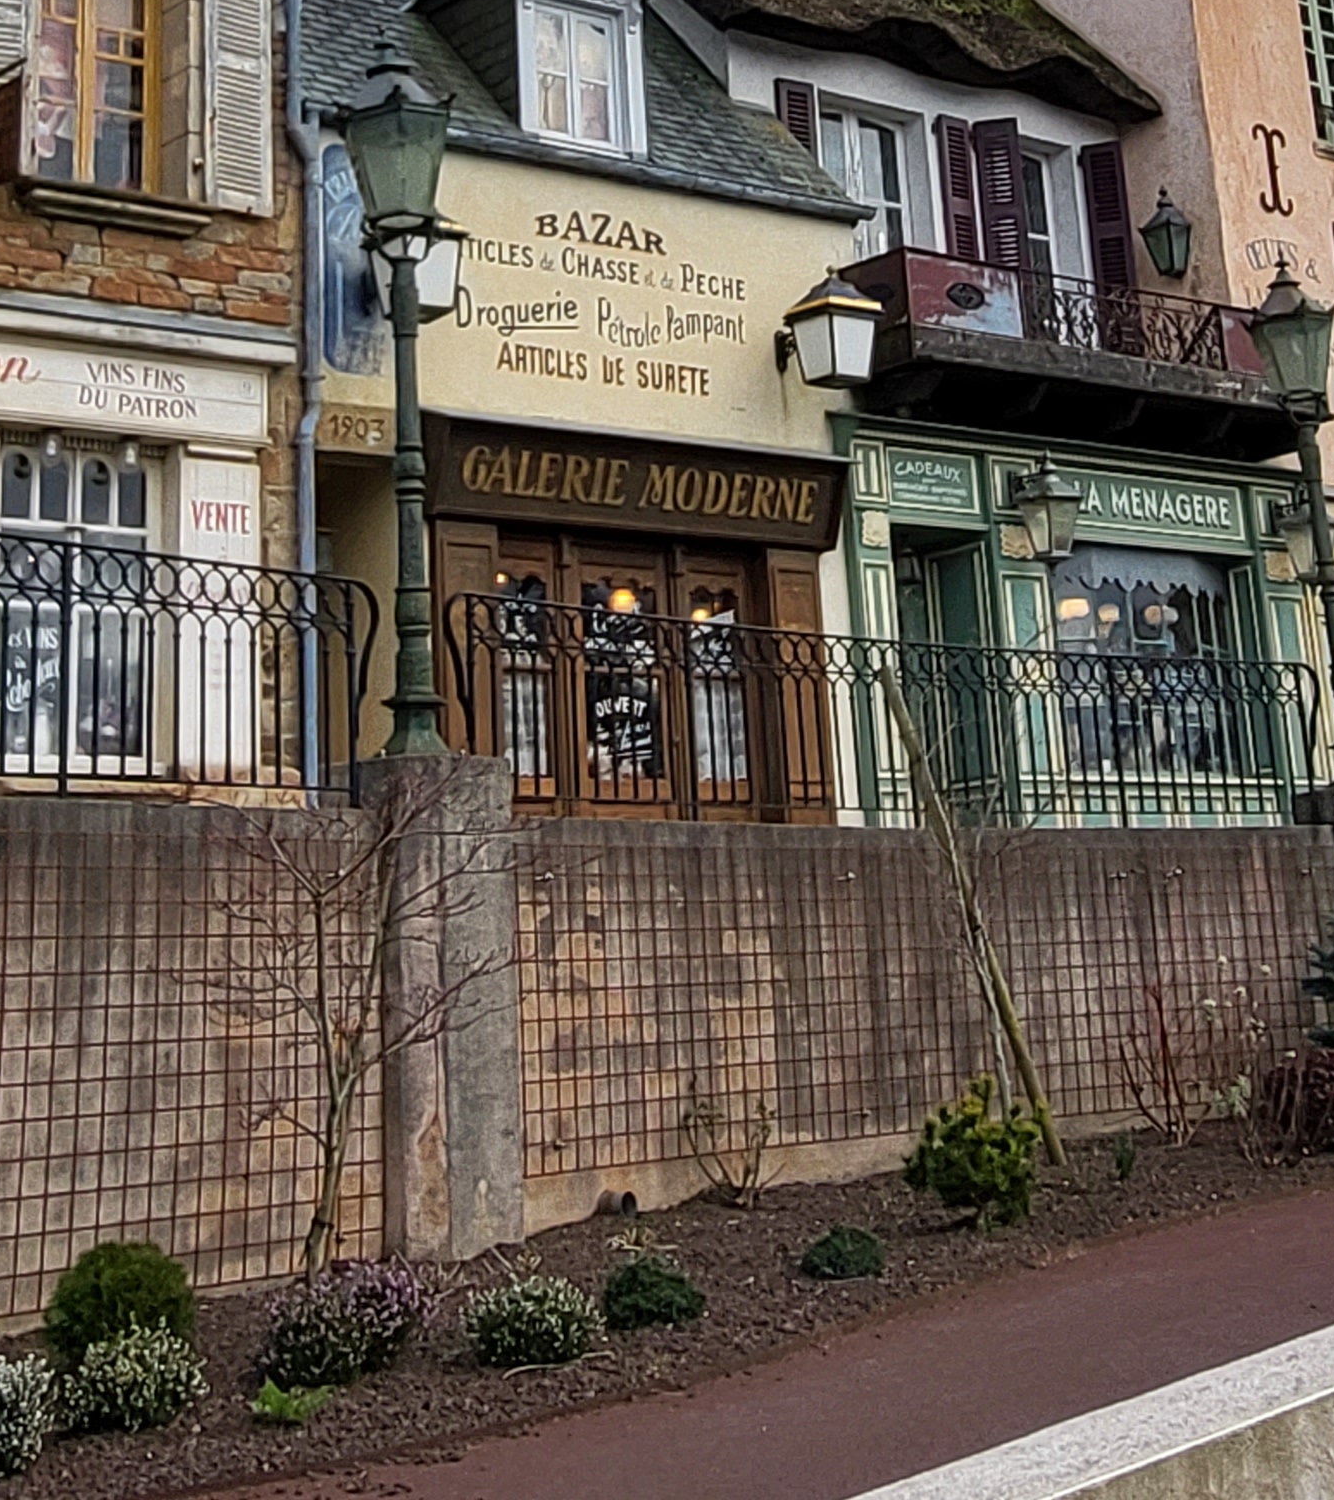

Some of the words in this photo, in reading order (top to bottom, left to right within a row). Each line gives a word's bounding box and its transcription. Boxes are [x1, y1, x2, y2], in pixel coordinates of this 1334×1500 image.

[535, 210, 667, 256] BAZAR
[464, 236, 535, 268] TICLES
[561, 247, 640, 285] CHASSE
[678, 263, 747, 301] PECHE
[455, 285, 580, 337] Droguerie
[597, 296, 661, 348] Pétrole
[85, 360, 136, 388] VINS
[142, 366, 187, 394] FINS
[496, 341, 588, 381] ARTICLES
[636, 360, 710, 397] SURETE
[77, 384, 109, 411] DU
[117, 394, 198, 419] PATRON
[328, 414, 385, 445] 1903
[462, 445, 630, 507] GALERIE
[638, 463, 819, 525] MODERNE
[894, 460, 962, 484] CADEAUX
[190, 499, 251, 535] VENTE
[1110, 482, 1233, 530] MENAGERE
